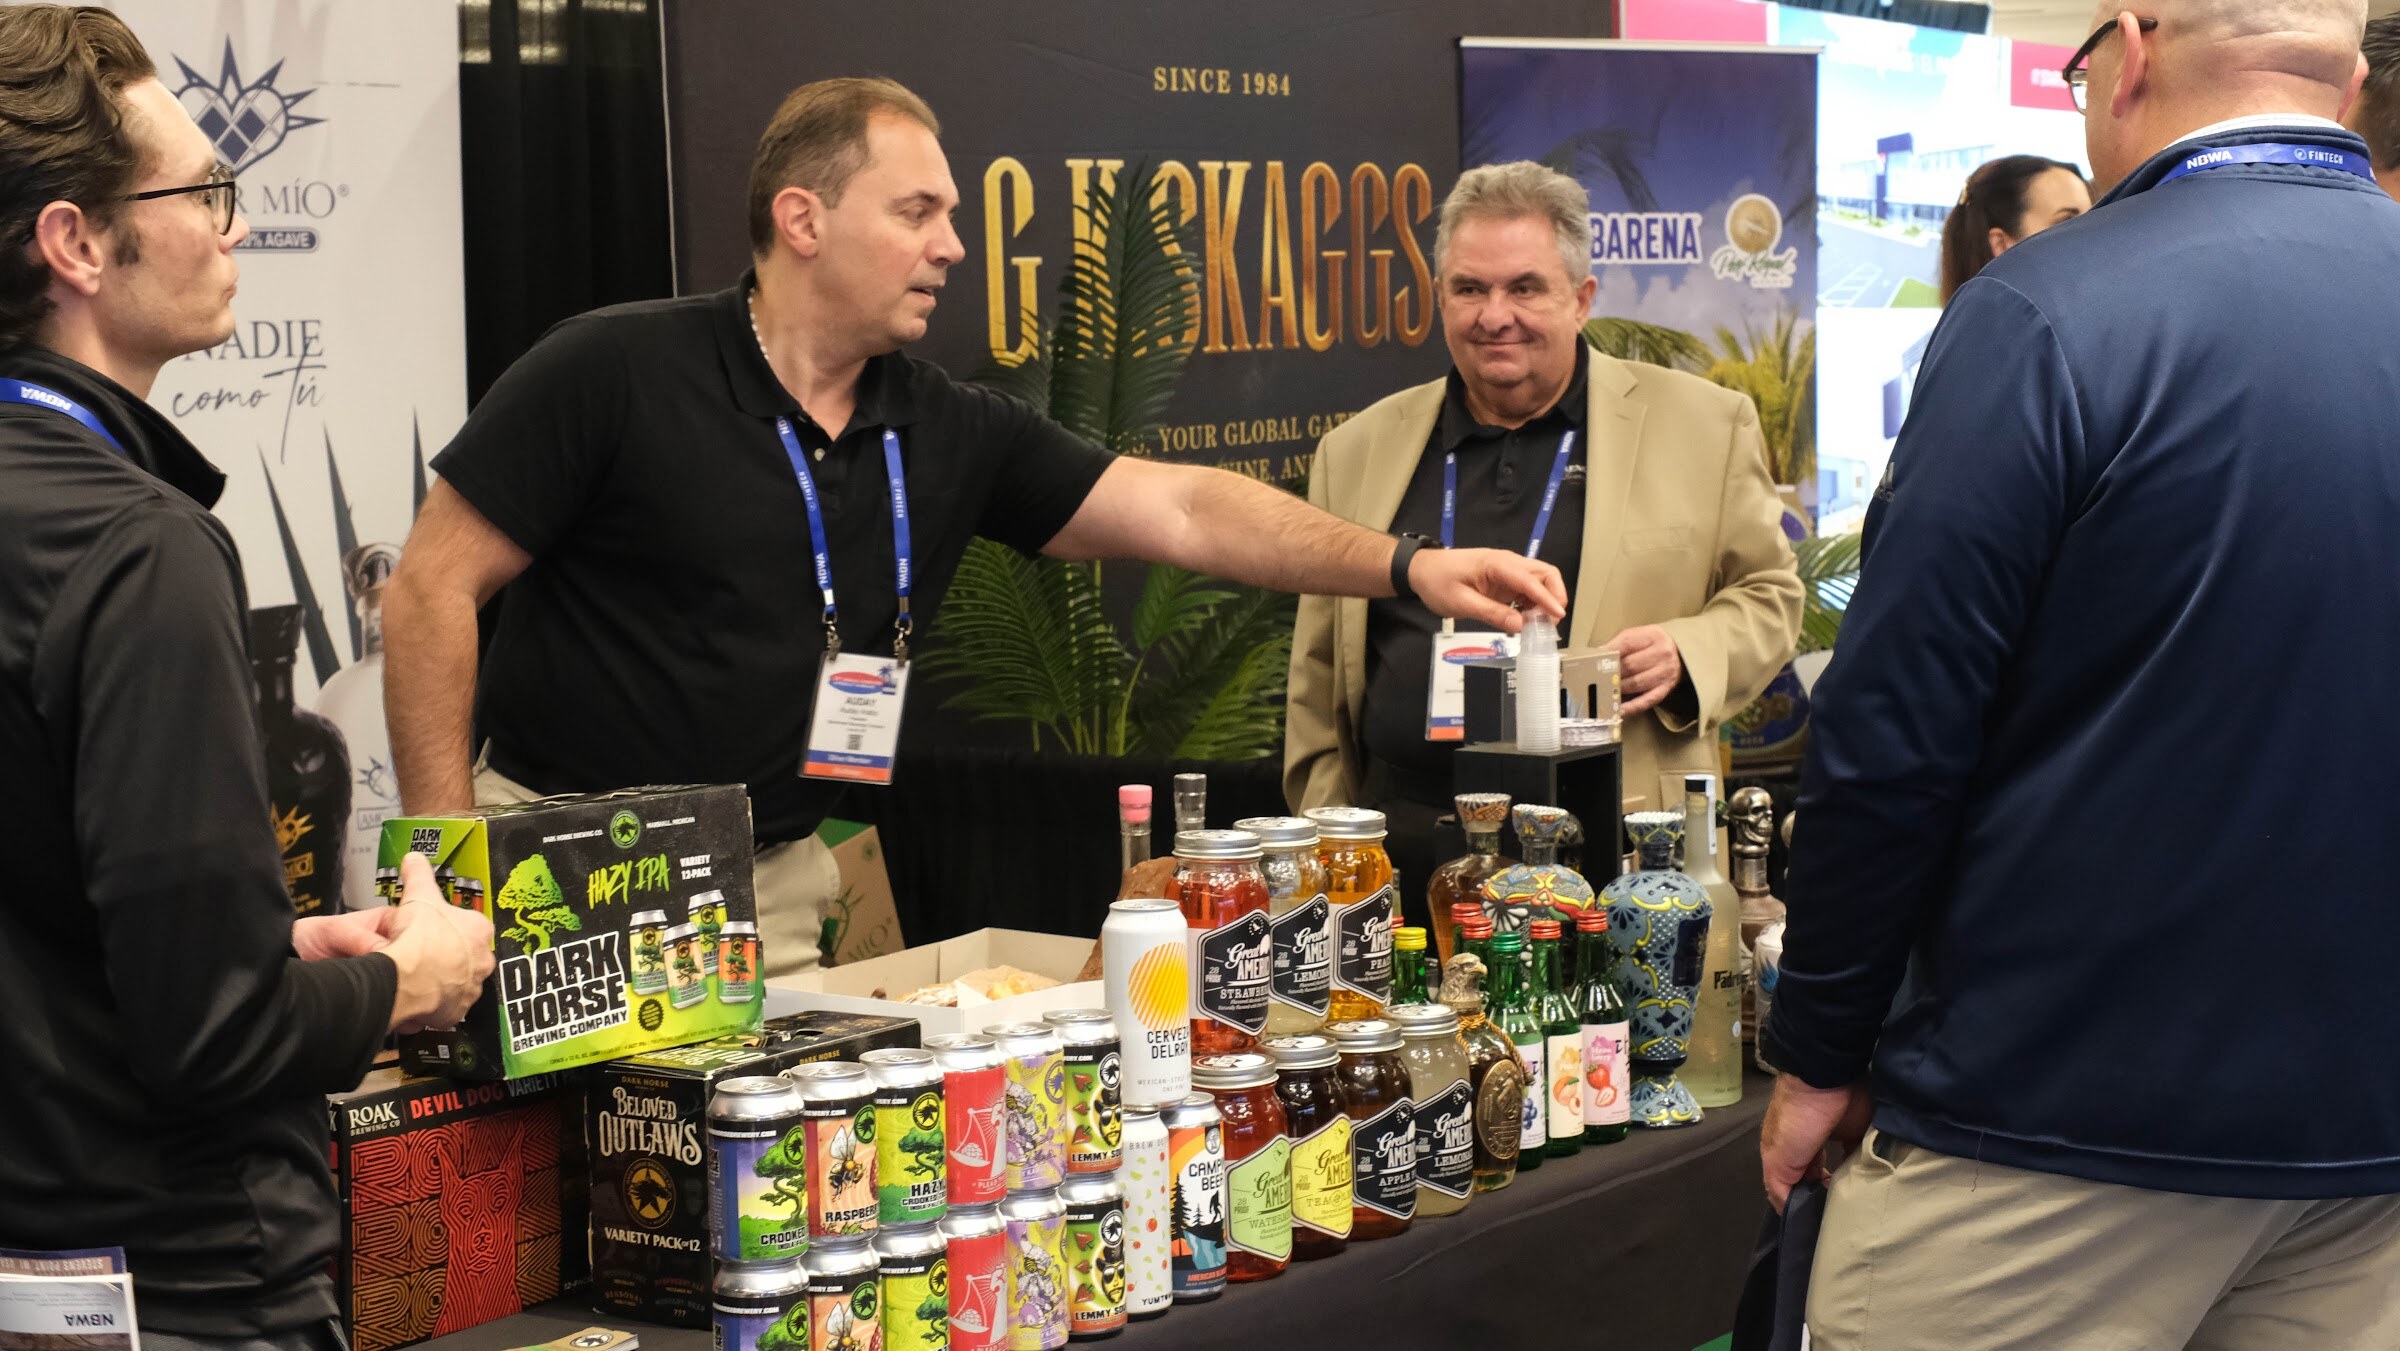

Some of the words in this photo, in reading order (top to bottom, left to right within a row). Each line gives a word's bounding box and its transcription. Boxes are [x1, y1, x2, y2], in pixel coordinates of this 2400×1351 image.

[1153, 66, 1231, 95] SINCE
[1241, 72, 1291, 97] 1984
[2186, 150, 2233, 169] NBWA
[2308, 151, 2344, 165] FINTECH
[264, 232, 310, 248] AGAVE
[173, 387, 270, 418] como
[1158, 424, 1218, 452] YOUR
[1223, 415, 1303, 447] GLOBAL
[410, 841, 440, 853] HORSE
[412, 829, 442, 841] DARK
[679, 854, 711, 868] VARIETY
[681, 867, 712, 880] 12-PACK
[587, 860, 633, 909] HAZY
[634, 853, 671, 892] IPA
[501, 932, 622, 1003] DARK
[506, 973, 628, 1038] HORSE
[513, 1028, 567, 1053] BREWING
[569, 1010, 628, 1036] COMPANY
[409, 1091, 464, 1120] DEVIL
[465, 1079, 504, 1105] DOG
[507, 1072, 560, 1098] VARIETY
[612, 1086, 678, 1121] BELOVED
[348, 1101, 399, 1130] ROAK
[350, 1122, 388, 1137] BREWING
[598, 1110, 703, 1167] OUTLAWS
[1072, 1151, 1108, 1162] LEMMY
[1378, 1173, 1411, 1187] APPLE
[604, 1226, 651, 1246] VARIETY
[652, 1234, 683, 1250] PACK
[689, 1239, 701, 1252] 12
[64, 1313, 114, 1326] NBWA
[1075, 1309, 1111, 1320] LEMMY
